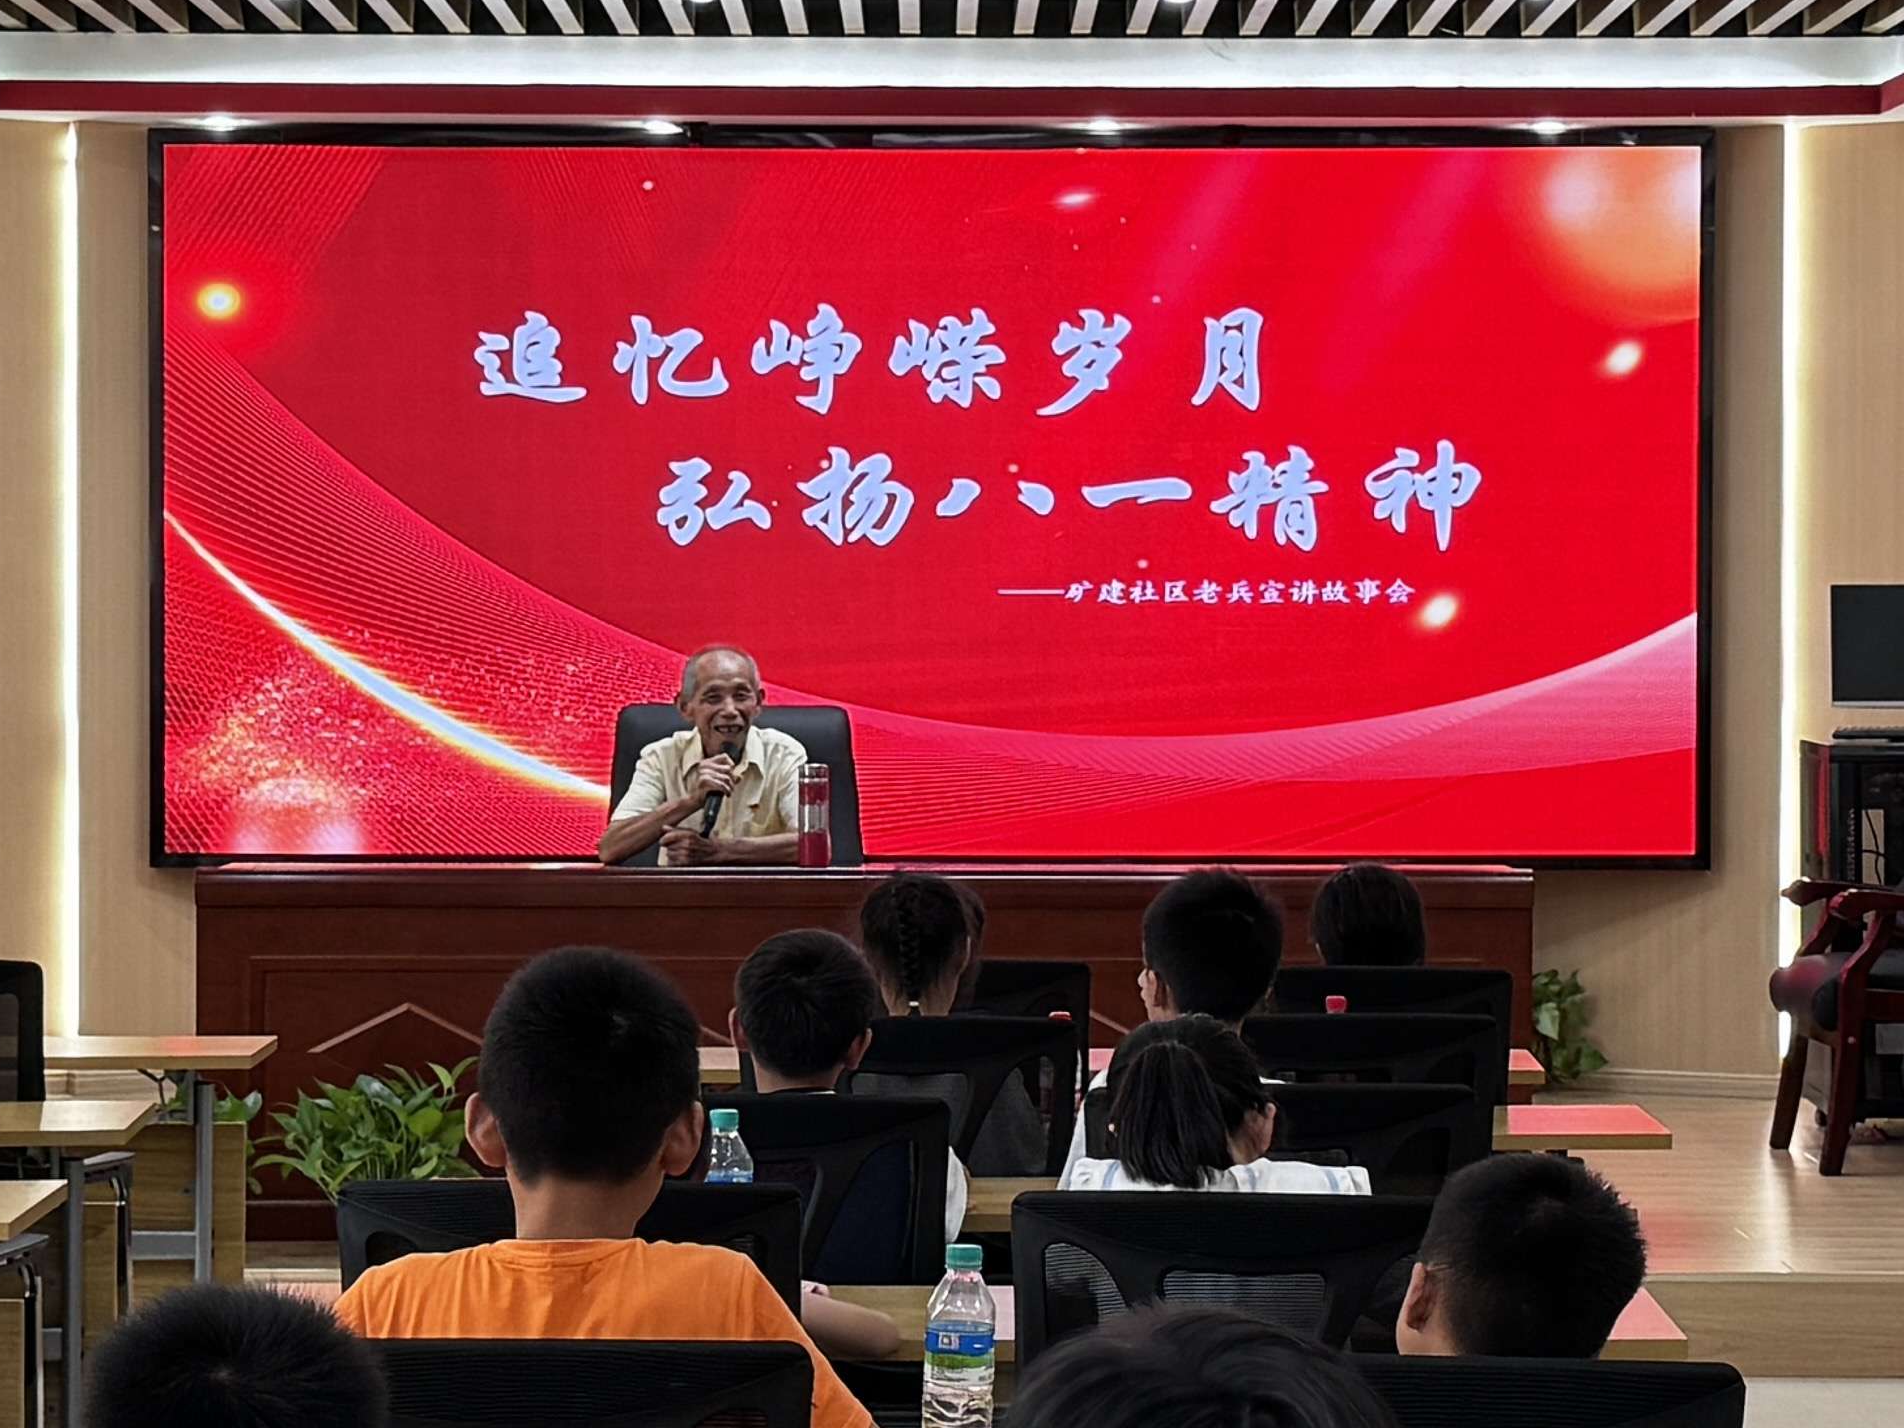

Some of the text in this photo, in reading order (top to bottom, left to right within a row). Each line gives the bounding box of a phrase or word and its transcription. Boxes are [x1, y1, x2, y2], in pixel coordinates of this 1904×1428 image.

[473, 301, 1264, 416] 追忆峥嵘岁月
[656, 439, 1483, 552] 弘扬八一精神
